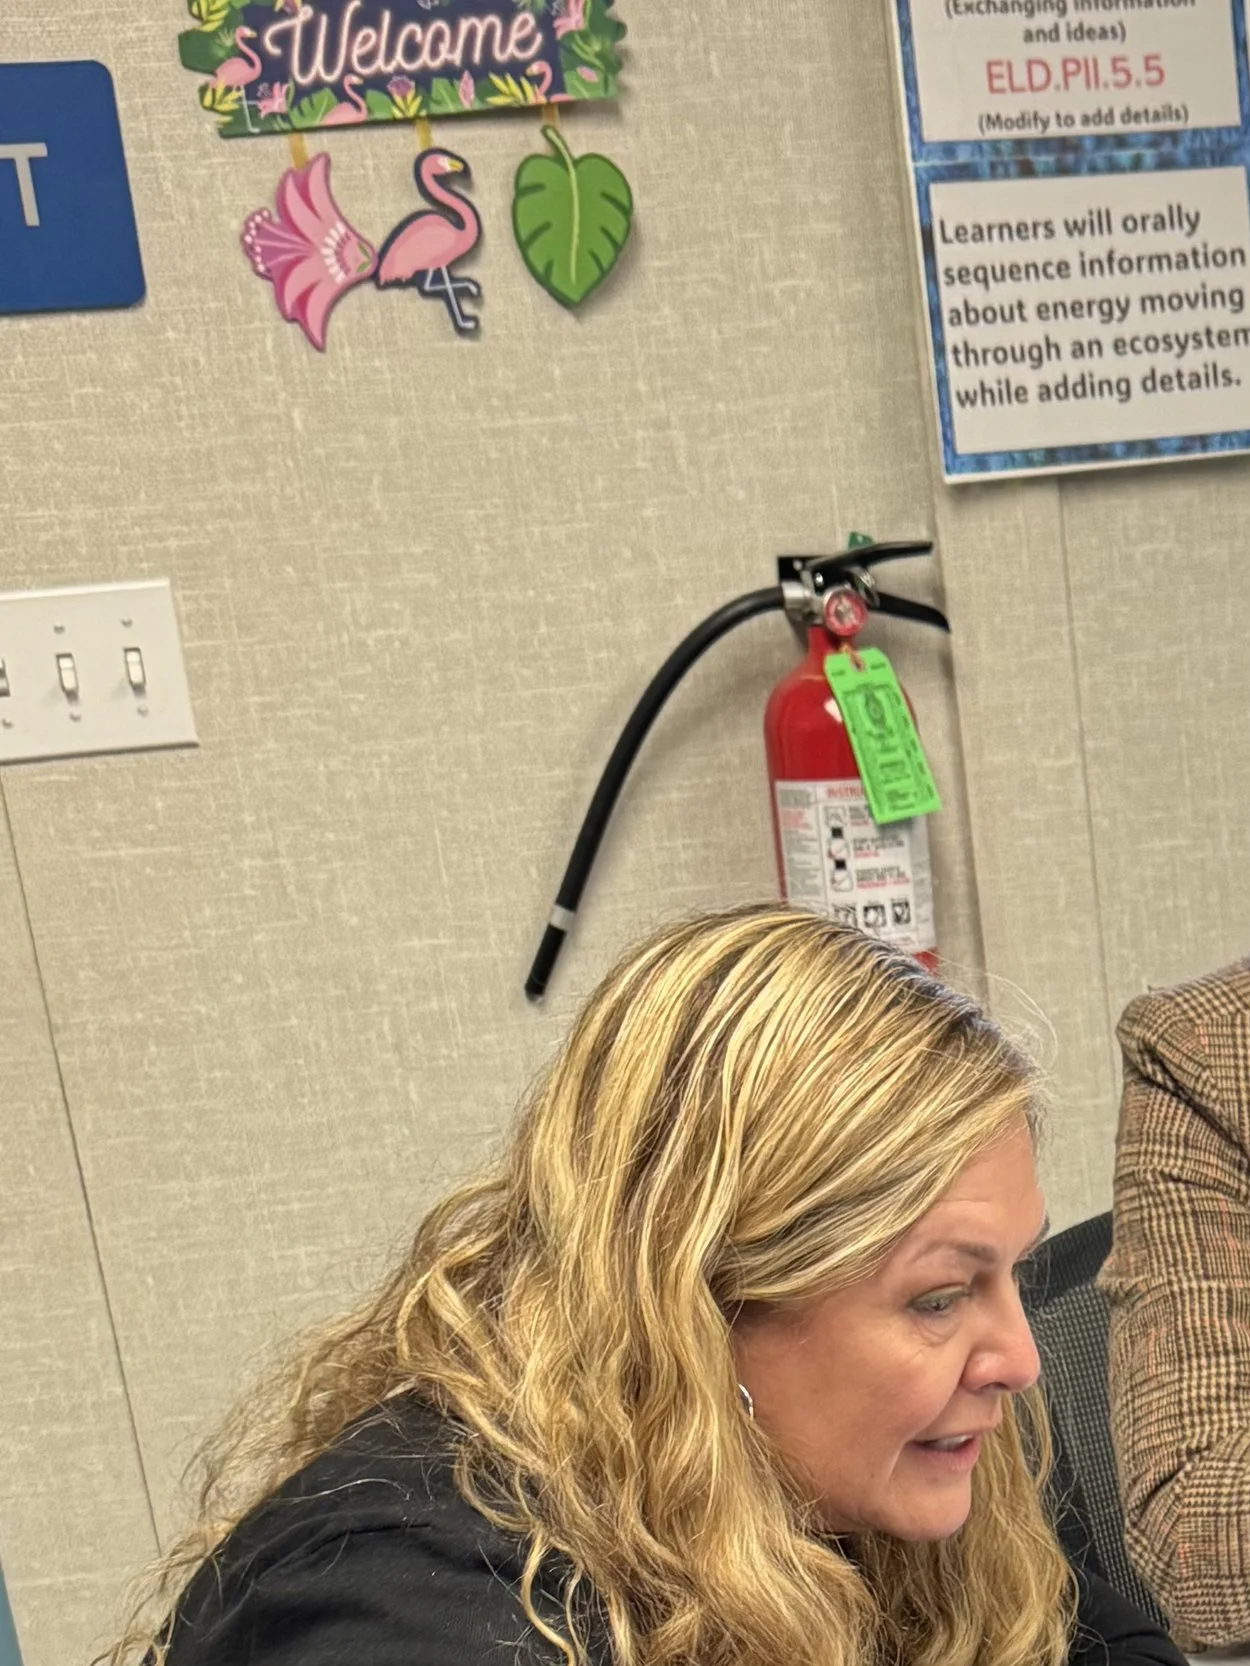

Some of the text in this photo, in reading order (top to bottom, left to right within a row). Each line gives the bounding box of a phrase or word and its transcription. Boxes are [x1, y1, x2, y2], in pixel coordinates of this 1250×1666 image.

[263, 0, 543, 85] Welcome
[1023, 20, 1126, 44] and ideas)
[978, 104, 1189, 134] (Modify to add details)
[939, 204, 1201, 245] Learners will orally
[943, 244, 1246, 291] sequence information
[948, 284, 1245, 327] about energy moving
[951, 335, 1061, 370] through
[1071, 339, 1103, 360] an
[956, 362, 1241, 409] while adding details.
